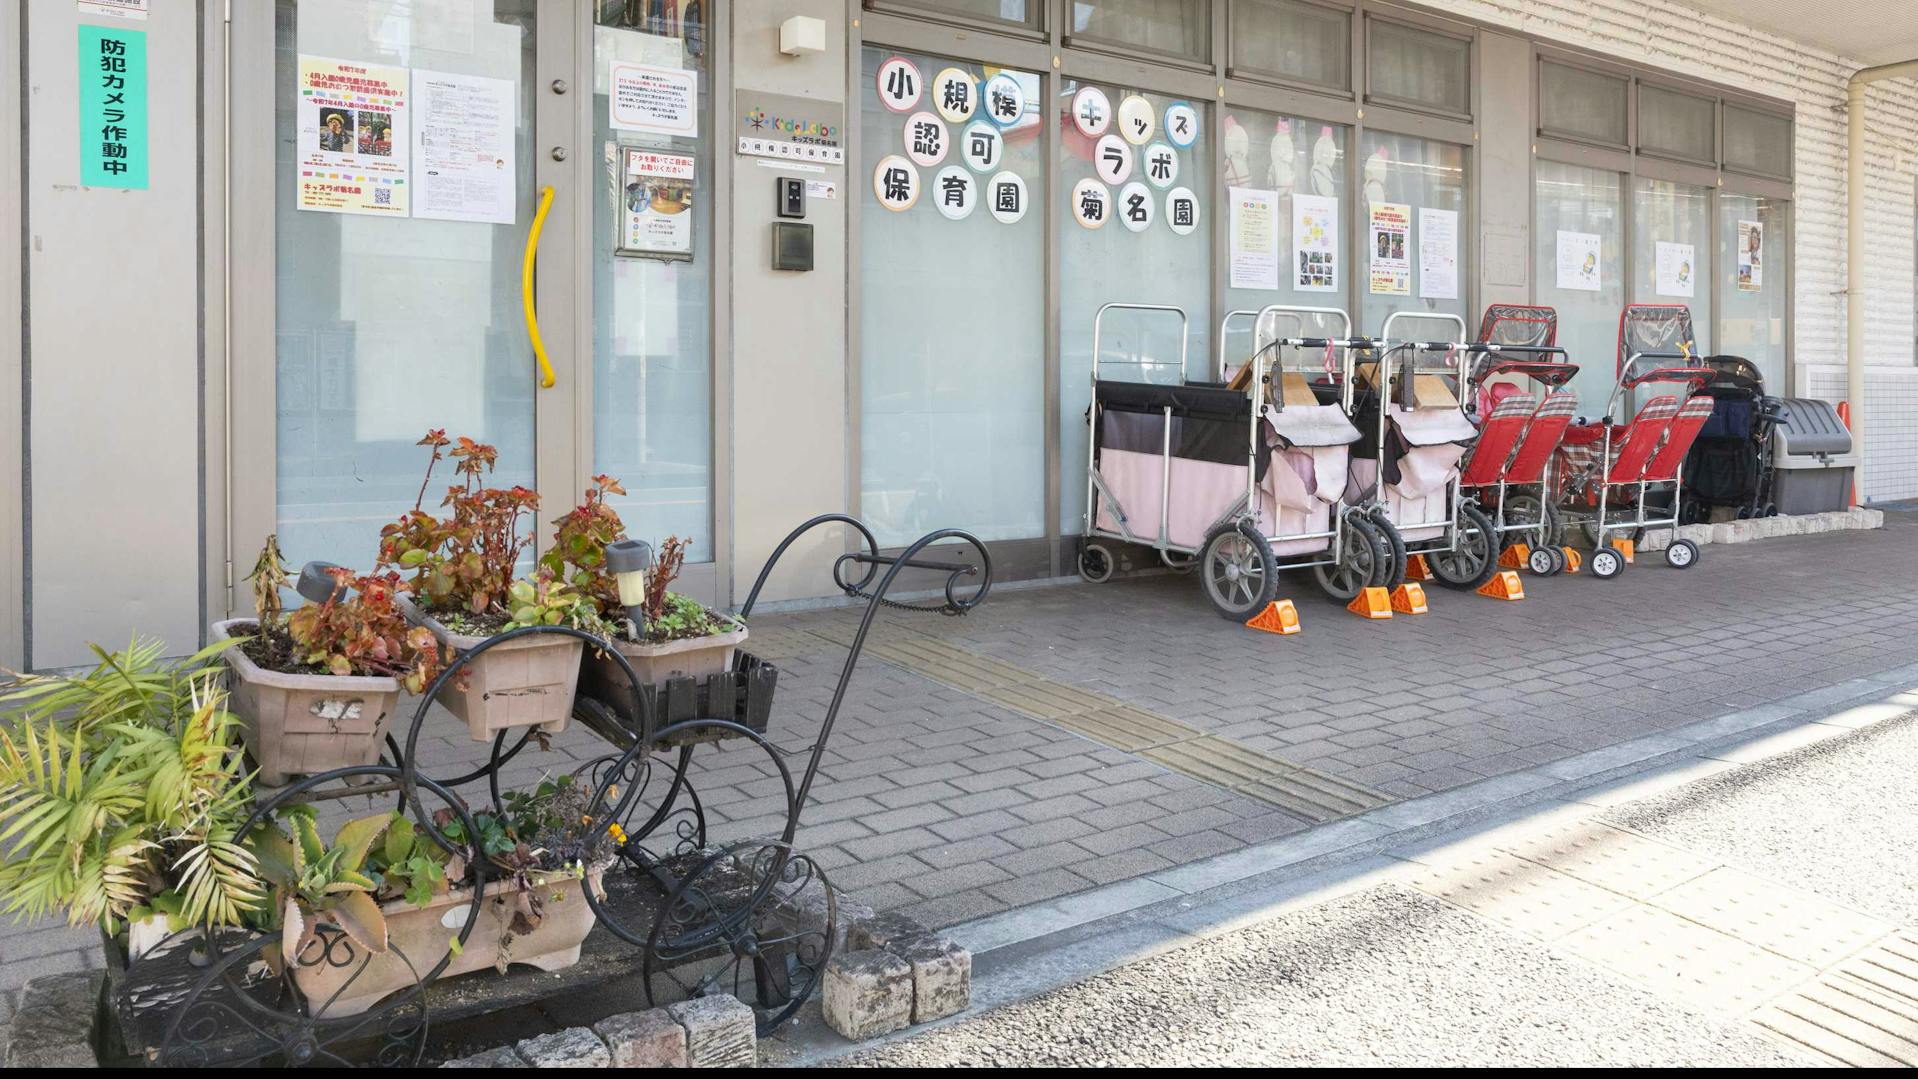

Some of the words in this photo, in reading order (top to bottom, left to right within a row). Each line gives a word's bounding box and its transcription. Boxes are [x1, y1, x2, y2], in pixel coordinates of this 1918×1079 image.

[100, 38, 128, 176] 防犯カメラ作動中
[887, 67, 1017, 117] 小規模
[631, 154, 693, 167] フタを開いてご自由に
[913, 121, 995, 165] 認可
[1103, 146, 1172, 180] ラボ
[641, 163, 684, 174] お取りください
[883, 167, 1020, 213] 保育園
[1080, 189, 1193, 226] 菊名園
